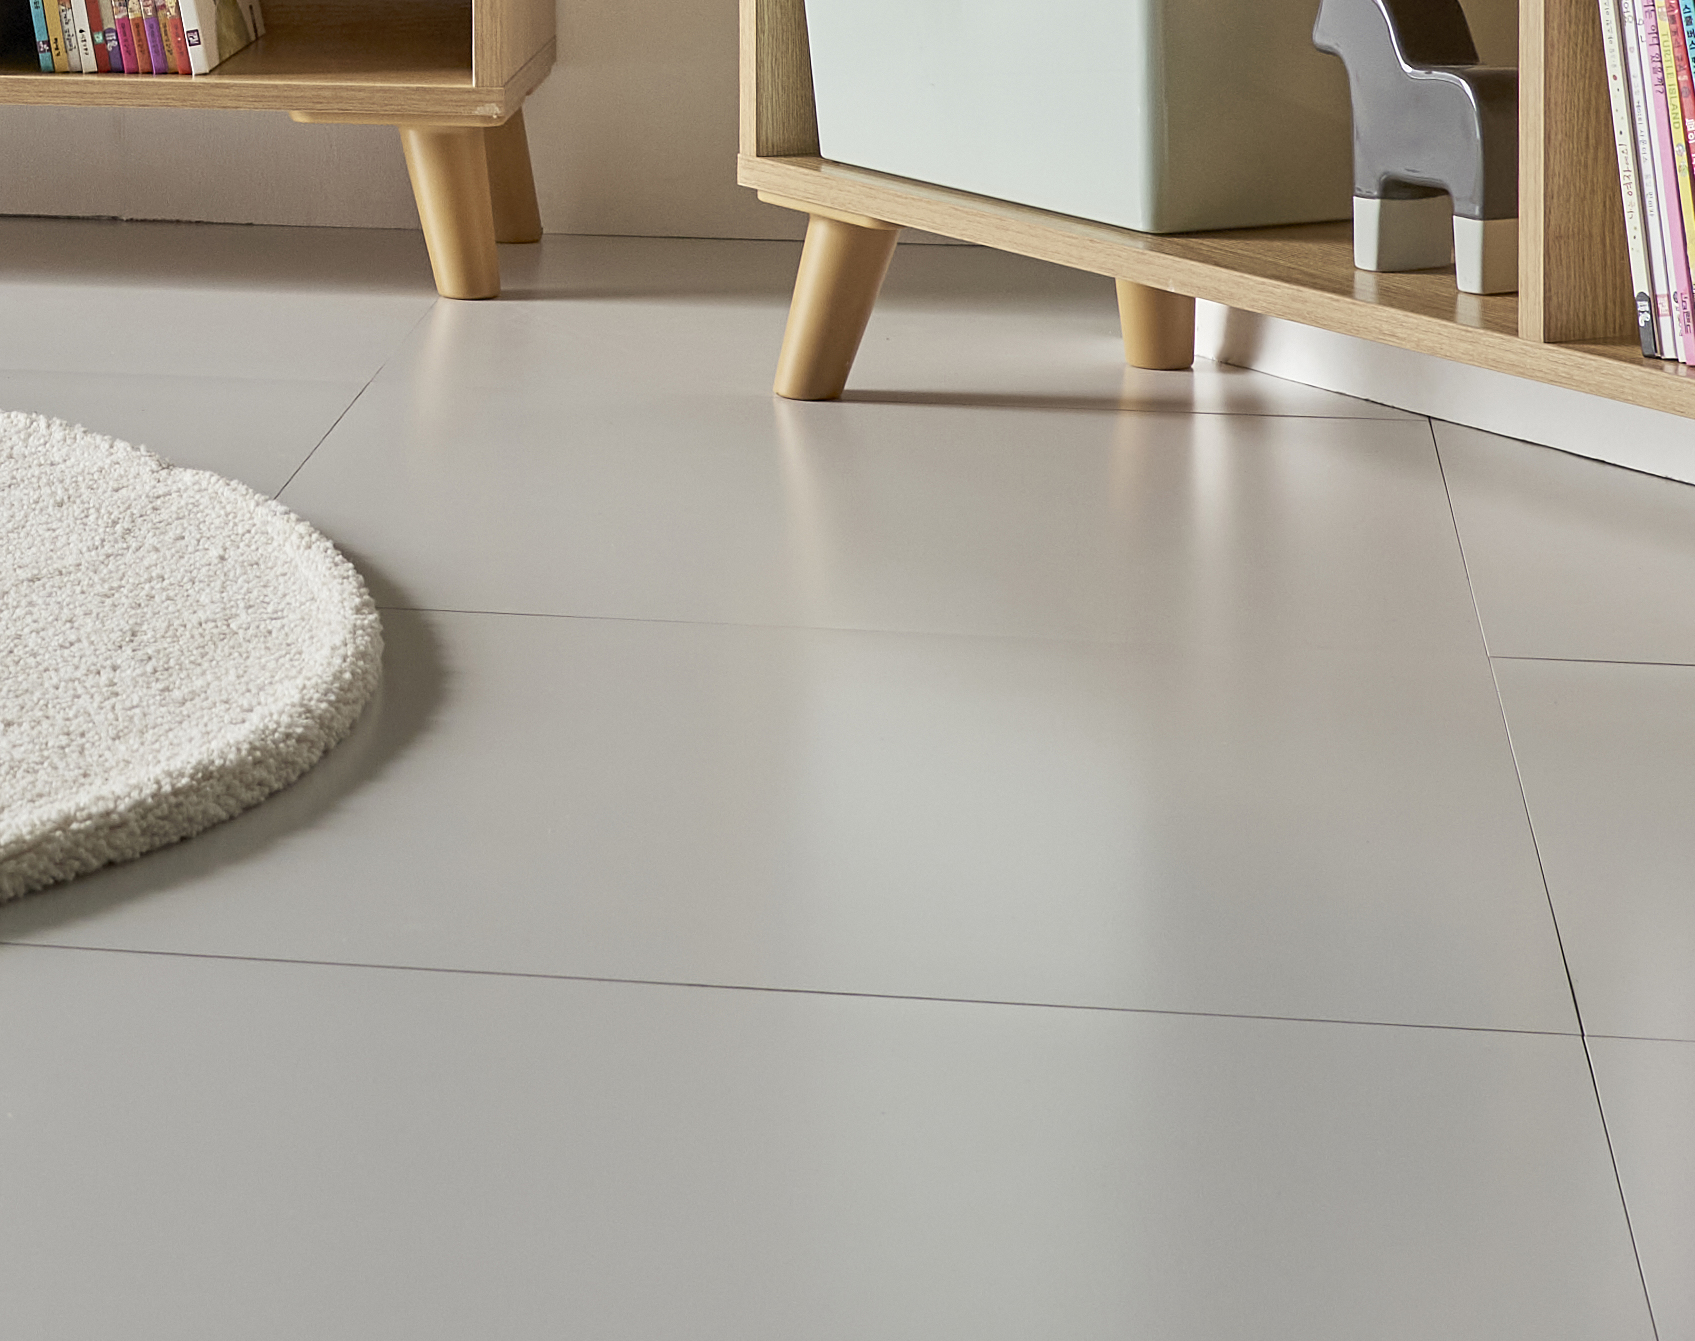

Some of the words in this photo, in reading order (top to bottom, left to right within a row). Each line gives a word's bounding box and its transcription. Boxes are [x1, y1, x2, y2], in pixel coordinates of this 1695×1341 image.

[1680, 3, 1694, 26] 스쿨
[1660, 30, 1674, 79] TURTLE
[1667, 83, 1681, 129] ISLAND
